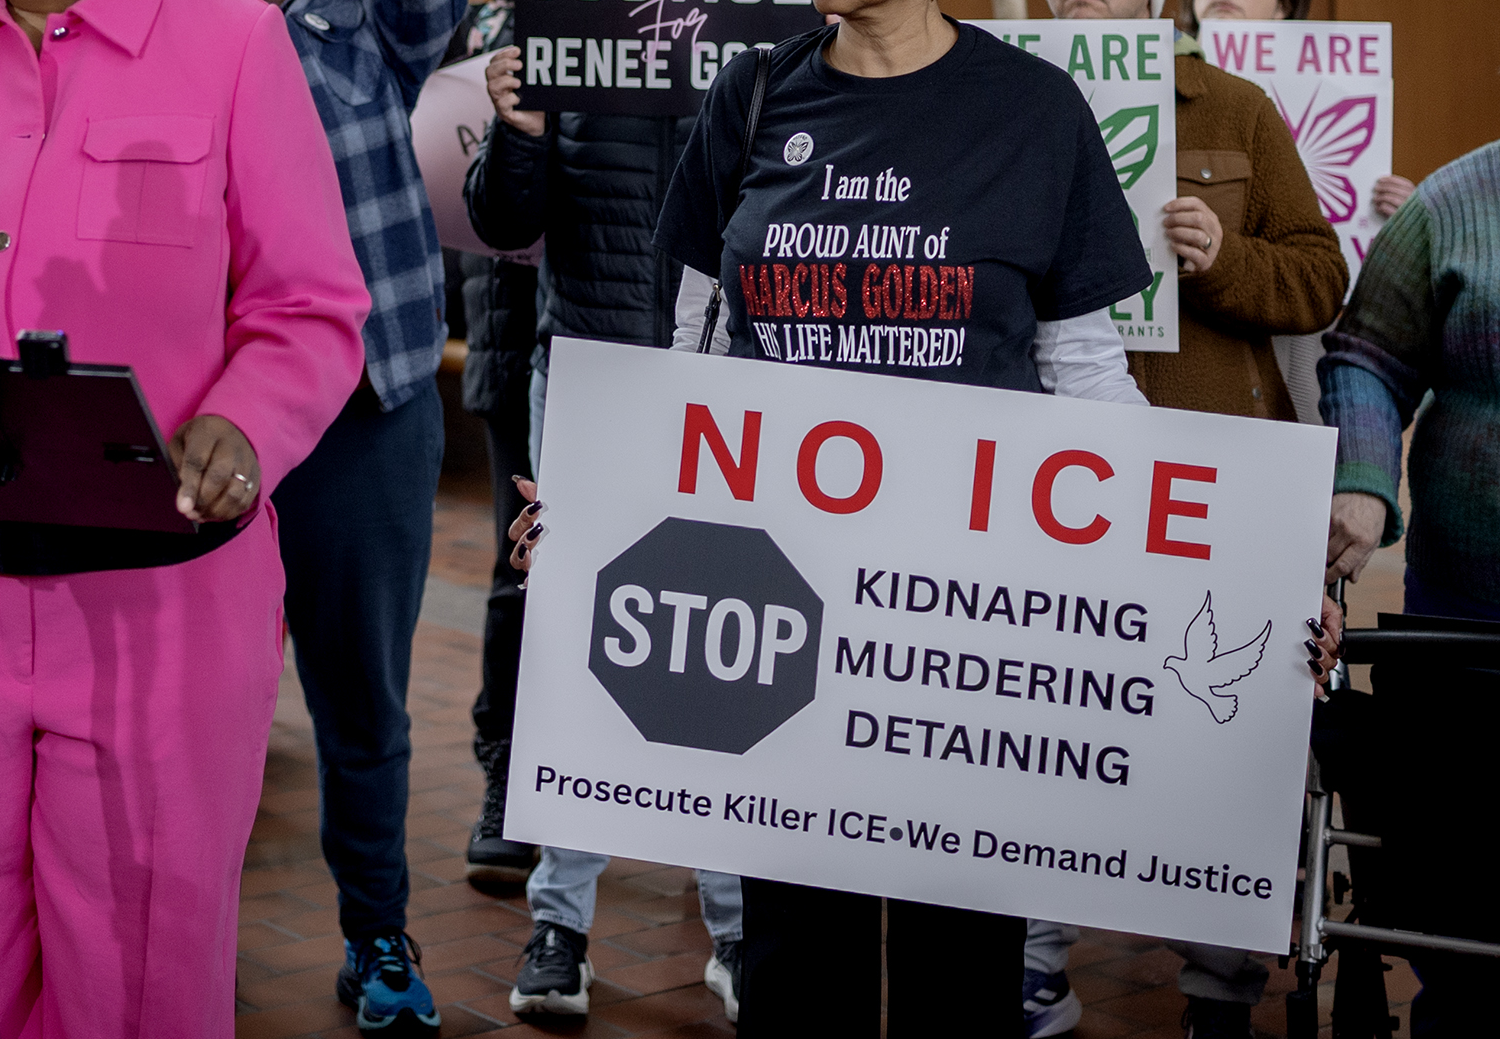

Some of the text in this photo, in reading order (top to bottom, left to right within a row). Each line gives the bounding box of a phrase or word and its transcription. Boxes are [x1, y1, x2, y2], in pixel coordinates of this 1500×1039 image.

[526, 36, 672, 89] RENEE
[1067, 34, 1161, 80] ARE
[1213, 32, 1380, 74] WE ARE
[821, 164, 911, 202] I am the
[763, 223, 950, 259] PROUD AUNT of
[740, 262, 975, 320] MARCUS GOLDEN
[783, 324, 833, 362] LIFE
[836, 325, 966, 367] MATTERED!
[677, 402, 1218, 560] NO ICE
[603, 583, 808, 686] STOP
[853, 567, 1149, 644] KIDNAPING
[834, 636, 1156, 717] MURDERING
[844, 710, 1130, 787] DETAINING
[534, 765, 713, 820] Prosecute
[724, 794, 817, 834] Killer
[973, 832, 1128, 880] Demand
[1137, 857, 1274, 900] Justice
